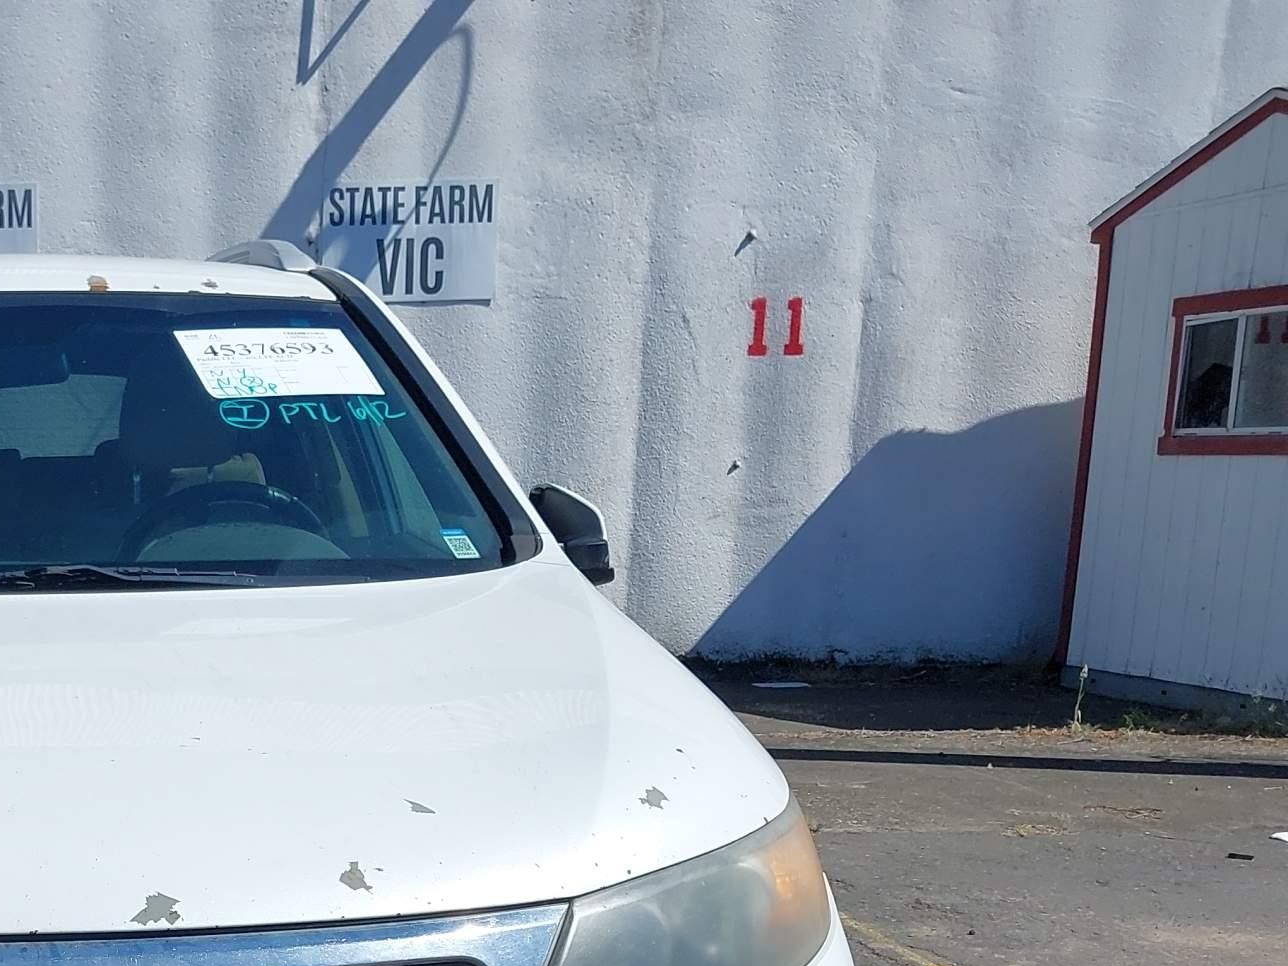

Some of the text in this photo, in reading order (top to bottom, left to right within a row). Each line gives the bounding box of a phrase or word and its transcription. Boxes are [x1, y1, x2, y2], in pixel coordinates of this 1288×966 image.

[329, 183, 494, 227] STATE FARM
[376, 236, 445, 297] VIC
[203, 342, 335, 357] 45376593
[746, 296, 805, 357] 11
